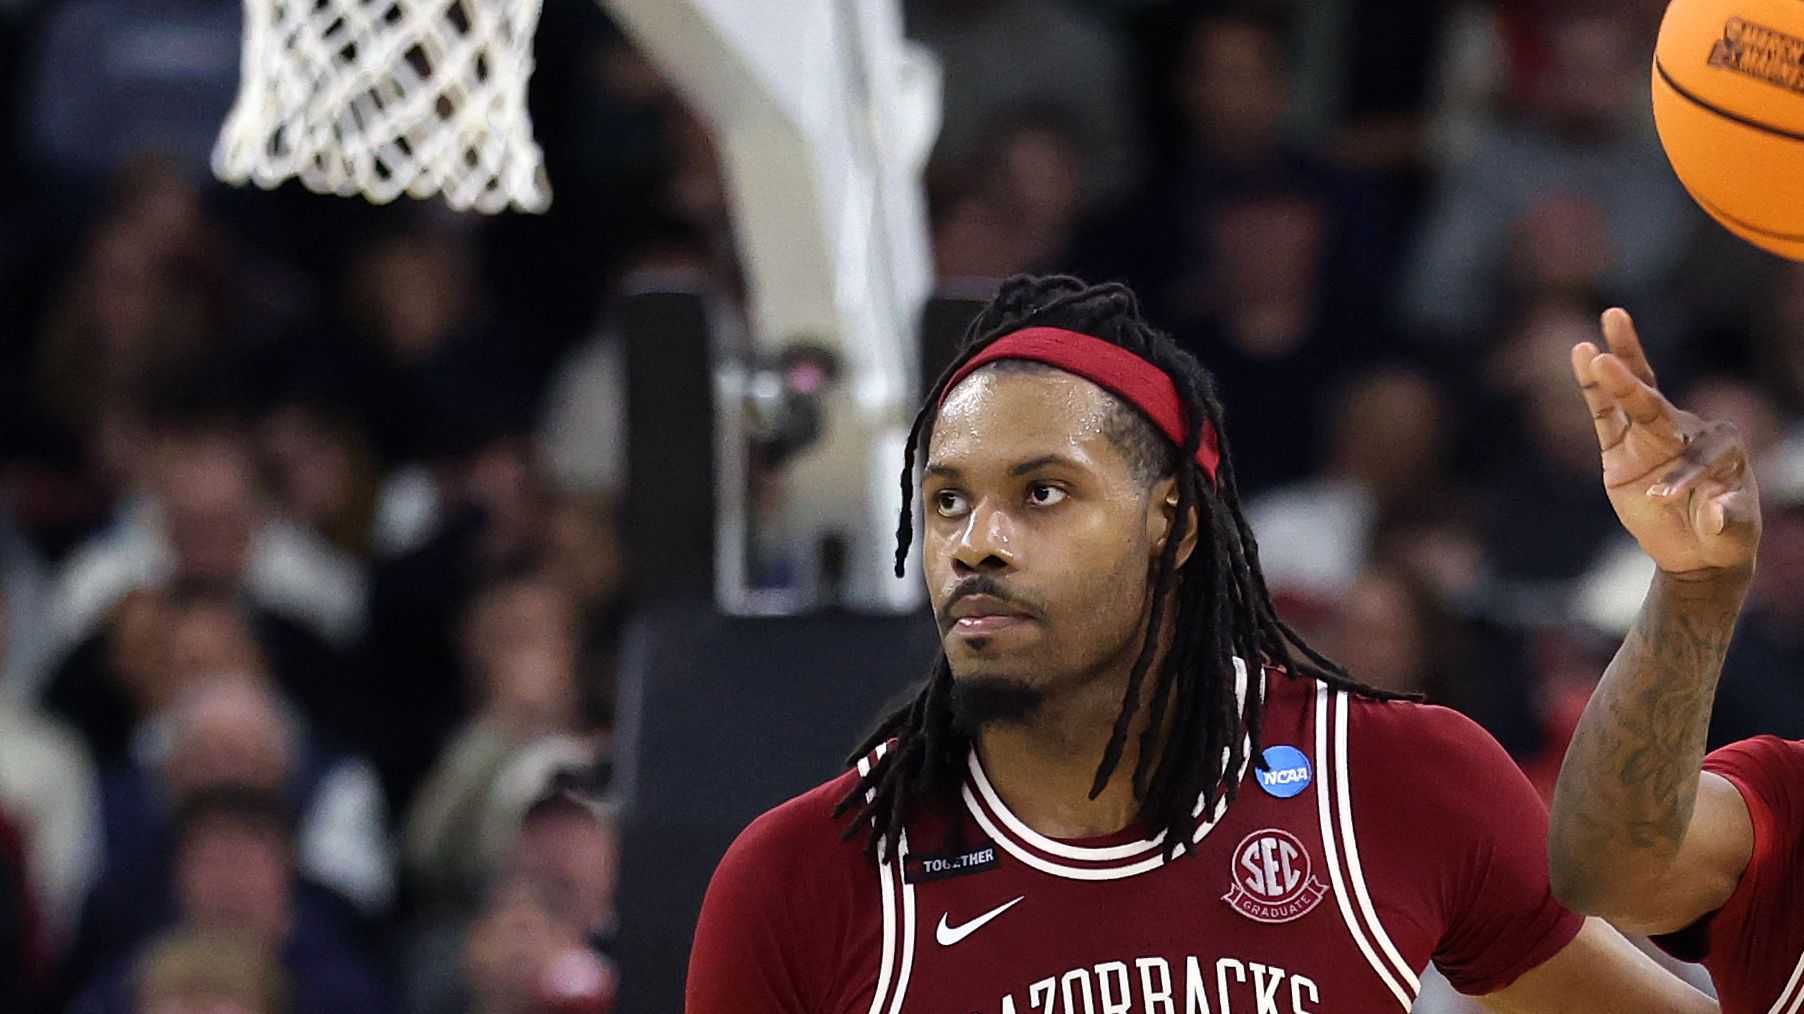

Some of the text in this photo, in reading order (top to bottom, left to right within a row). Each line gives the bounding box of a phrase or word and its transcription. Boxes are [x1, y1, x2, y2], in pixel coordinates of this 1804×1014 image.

[1263, 766, 1309, 786] NCAA
[1241, 837, 1302, 897] SEC
[1242, 892, 1313, 920] GRADUATE
